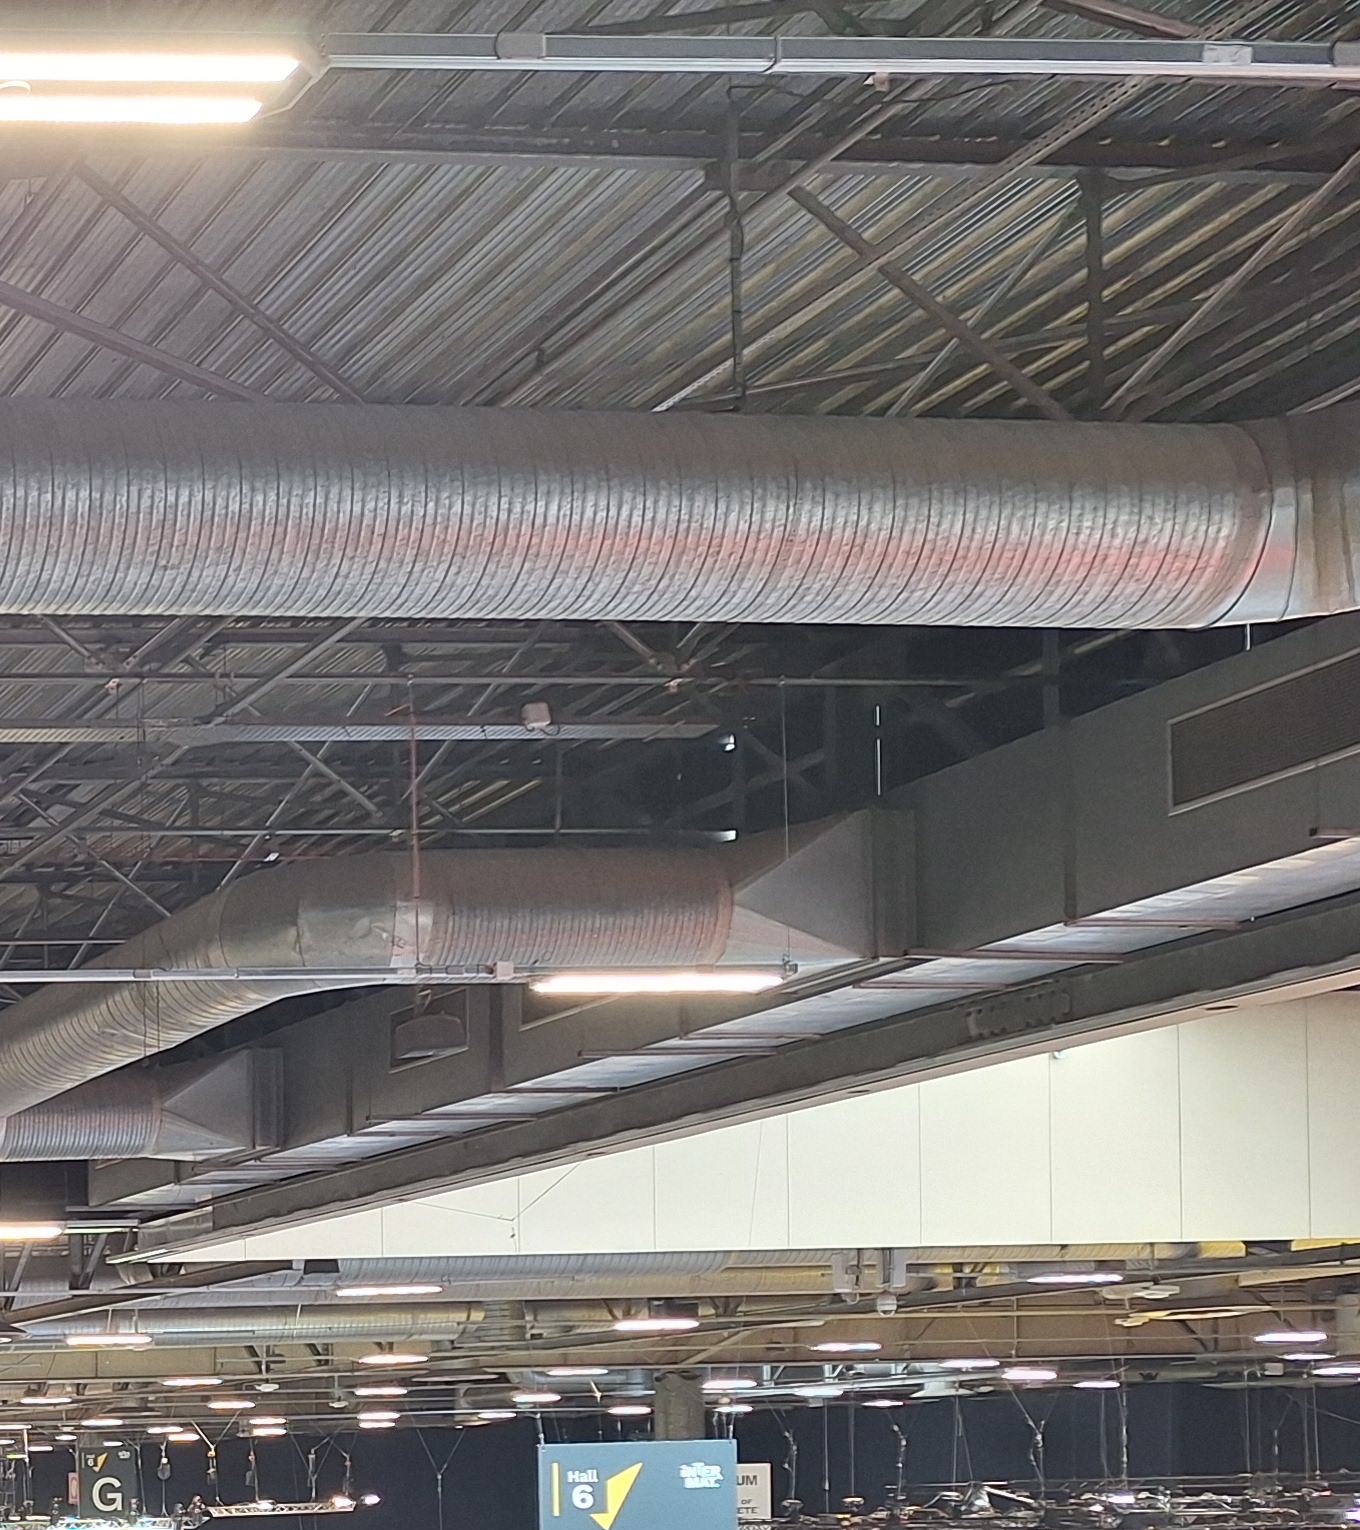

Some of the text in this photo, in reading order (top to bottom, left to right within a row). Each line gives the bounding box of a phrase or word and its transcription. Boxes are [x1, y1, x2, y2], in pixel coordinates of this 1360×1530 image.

[86, 1457, 95, 1467] 6
[566, 1469, 599, 1483] Hall
[736, 1474, 758, 1487] UM
[92, 1476, 123, 1512] G
[571, 1484, 595, 1509] 6
